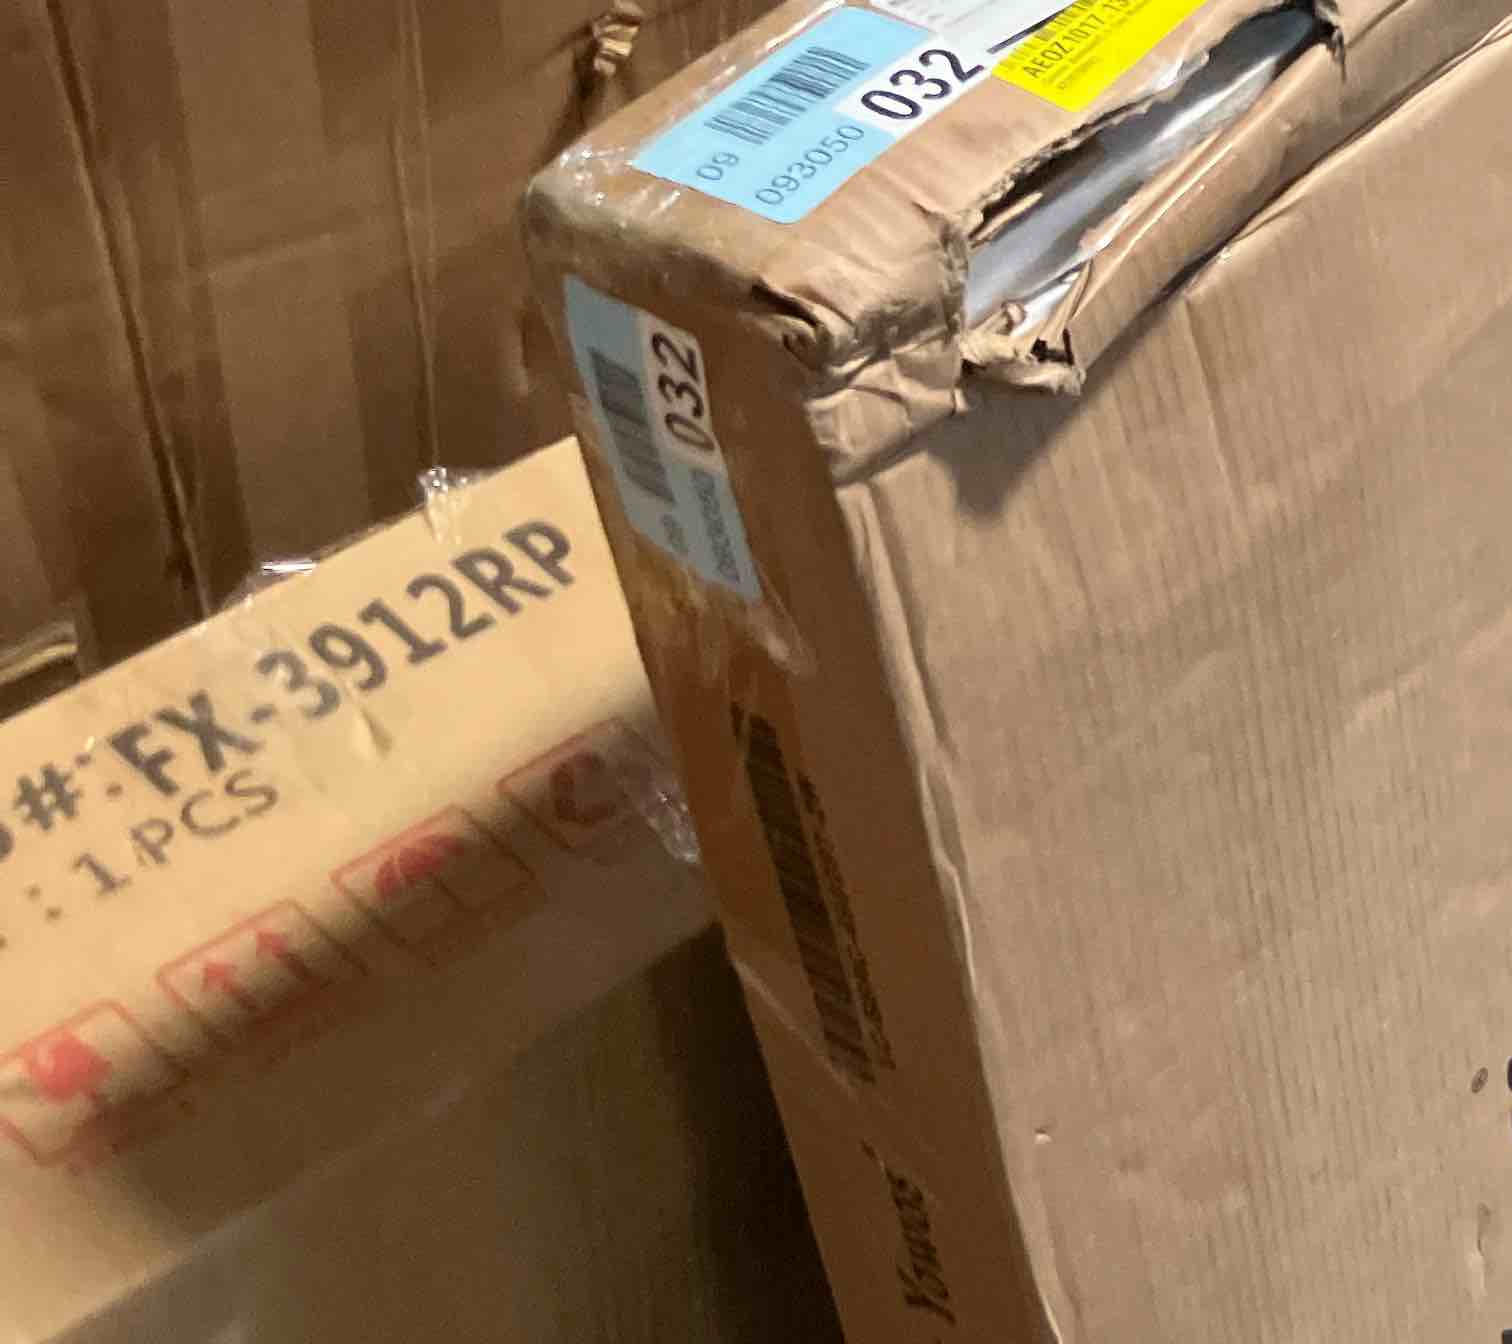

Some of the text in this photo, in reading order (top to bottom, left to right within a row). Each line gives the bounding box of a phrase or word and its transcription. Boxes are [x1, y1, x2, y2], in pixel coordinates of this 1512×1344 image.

[860, 48, 985, 120] 032
[695, 151, 740, 182] 09
[755, 125, 866, 207] 093050
[652, 332, 716, 452] 032
